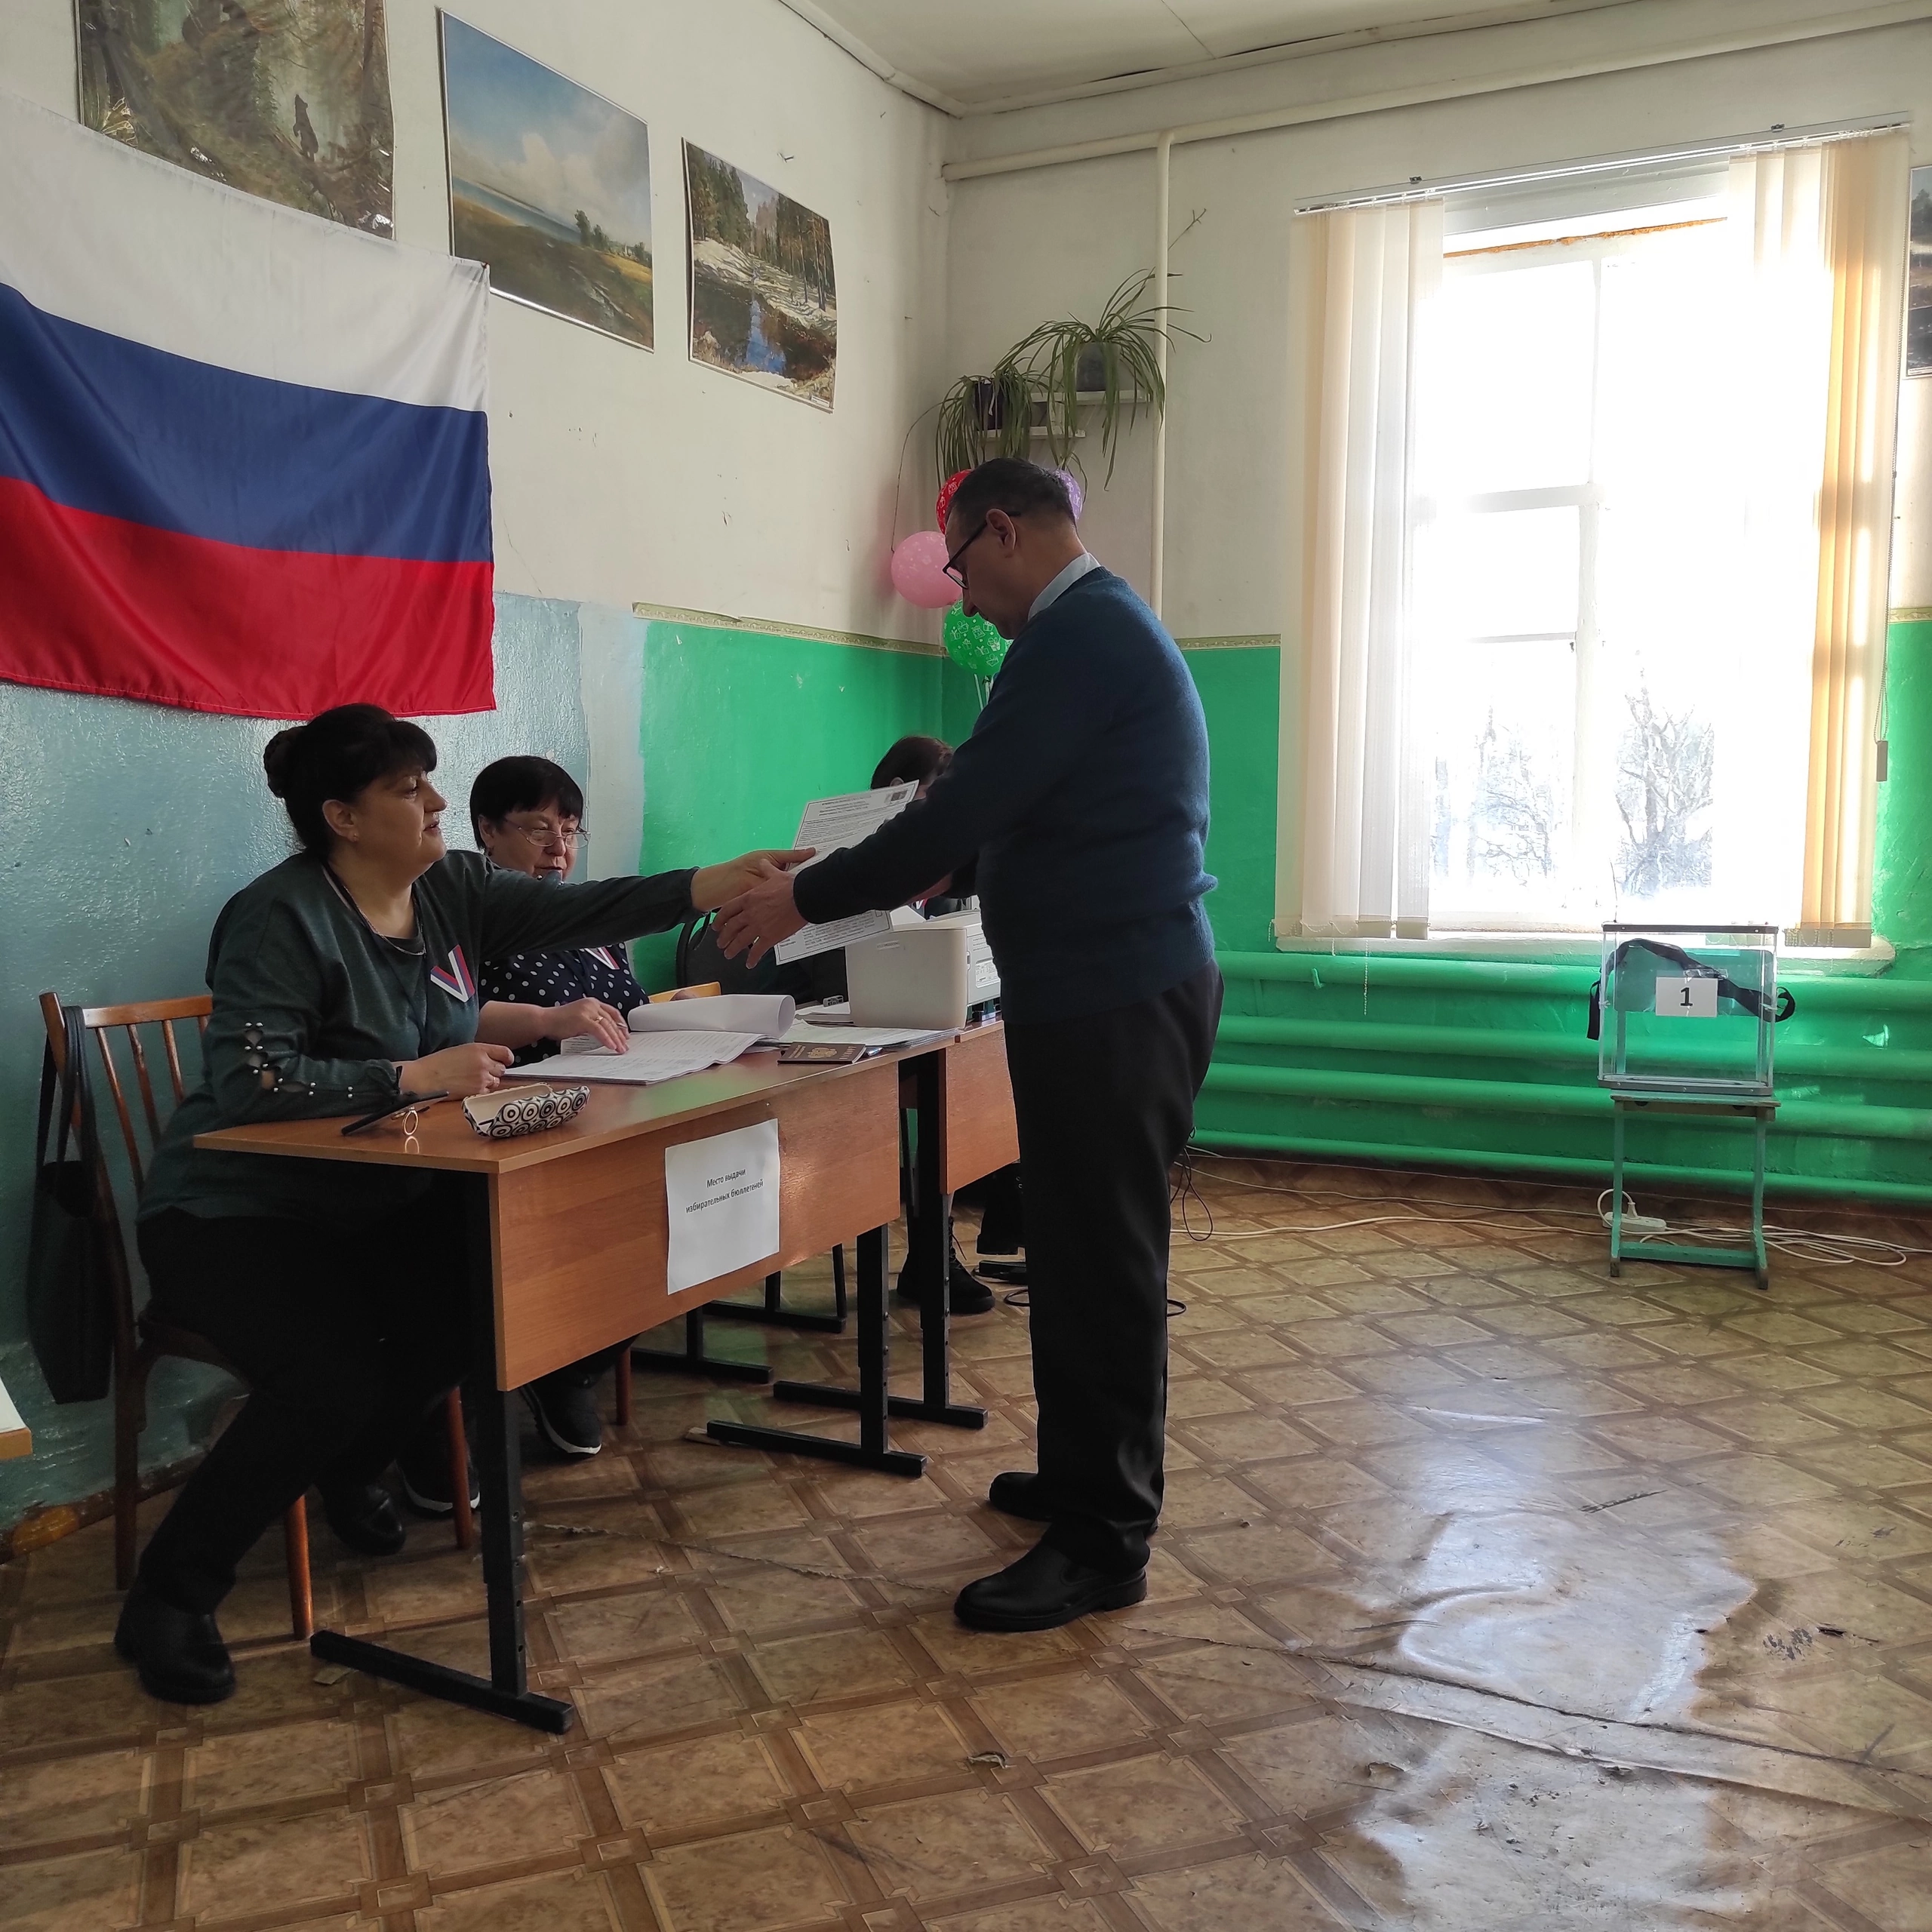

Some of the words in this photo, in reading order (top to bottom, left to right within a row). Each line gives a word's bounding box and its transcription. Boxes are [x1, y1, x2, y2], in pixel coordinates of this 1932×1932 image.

[1680, 987, 1693, 1006] 1
[706, 1176, 724, 1188] Место
[724, 1168, 746, 1182] выдачи
[685, 1192, 730, 1214] избирательных
[731, 1178, 764, 1198] бюллетеней
